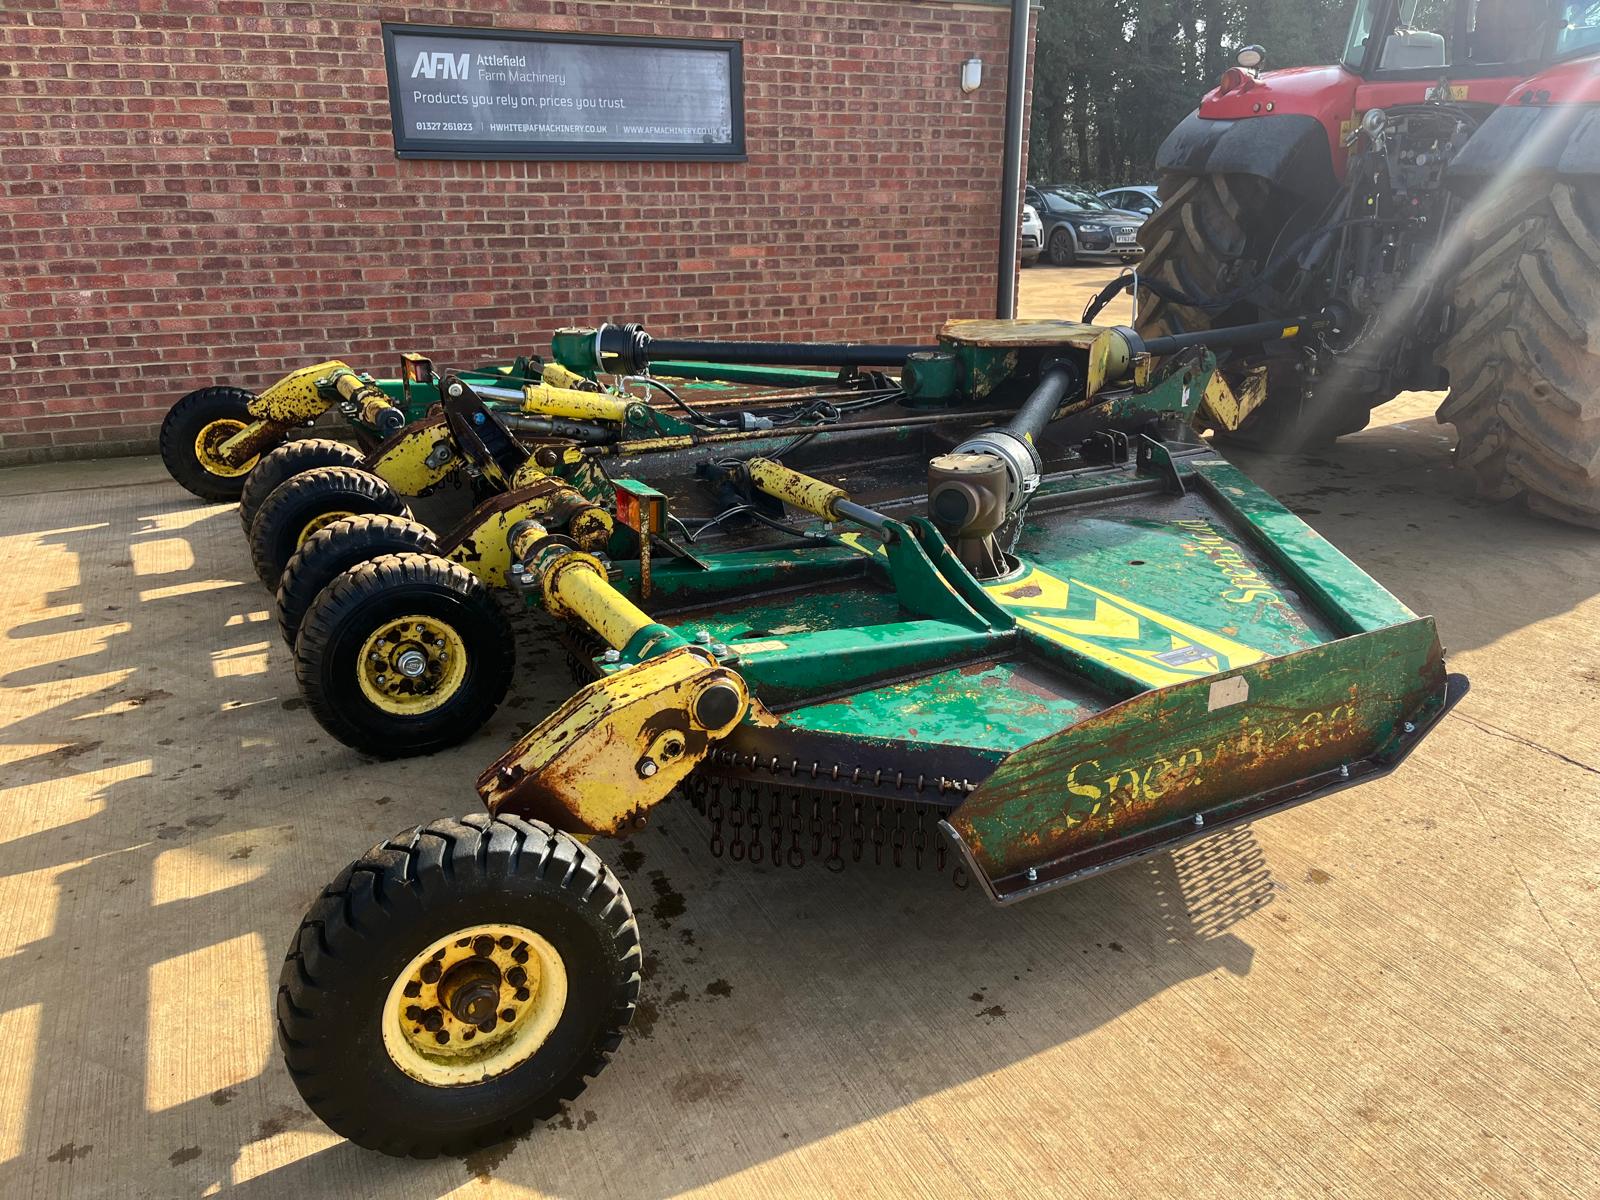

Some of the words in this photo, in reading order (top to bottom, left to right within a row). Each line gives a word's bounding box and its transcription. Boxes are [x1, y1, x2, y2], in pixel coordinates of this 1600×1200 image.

[411, 51, 470, 80] AFM
[476, 54, 526, 67] Attlefield
[478, 69, 506, 81] Farm
[508, 70, 566, 86] Machinery
[413, 91, 469, 105] Products
[471, 95, 493, 108] you
[496, 94, 518, 109] rely
[539, 95, 573, 109] prices
[575, 98, 597, 110] you
[599, 97, 625, 109] trust
[416, 121, 441, 131] 01327
[442, 122, 473, 132] 261023
[490, 123, 608, 134] HWHITE@AFMACHINERY.CO.UK
[623, 125, 718, 135] WWW.AFMACHINERY.CO.UK
